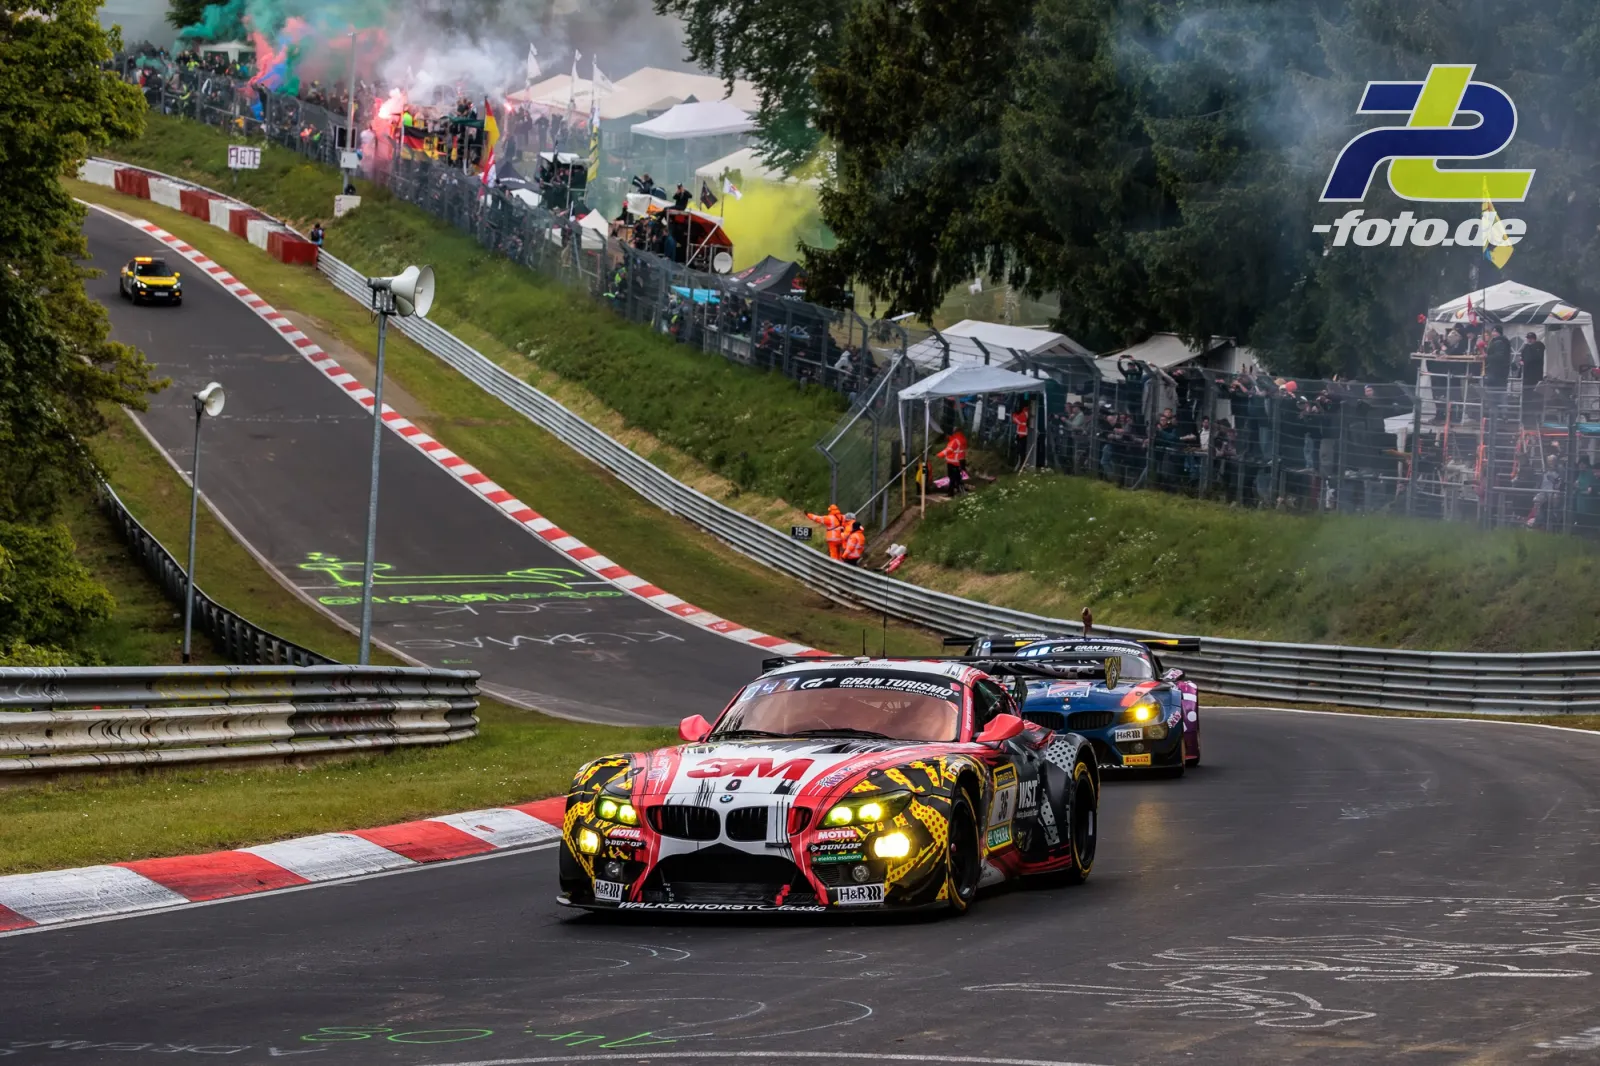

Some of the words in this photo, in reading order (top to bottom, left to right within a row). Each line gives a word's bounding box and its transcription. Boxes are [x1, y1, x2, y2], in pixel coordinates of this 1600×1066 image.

[840, 677, 885, 686] GRAN
[884, 678, 953, 697] TURISMO
[686, 757, 815, 781] 3M
[610, 828, 641, 838] MOTUL
[817, 829, 857, 840] MOTUL
[819, 842, 862, 851] DUNLOP
